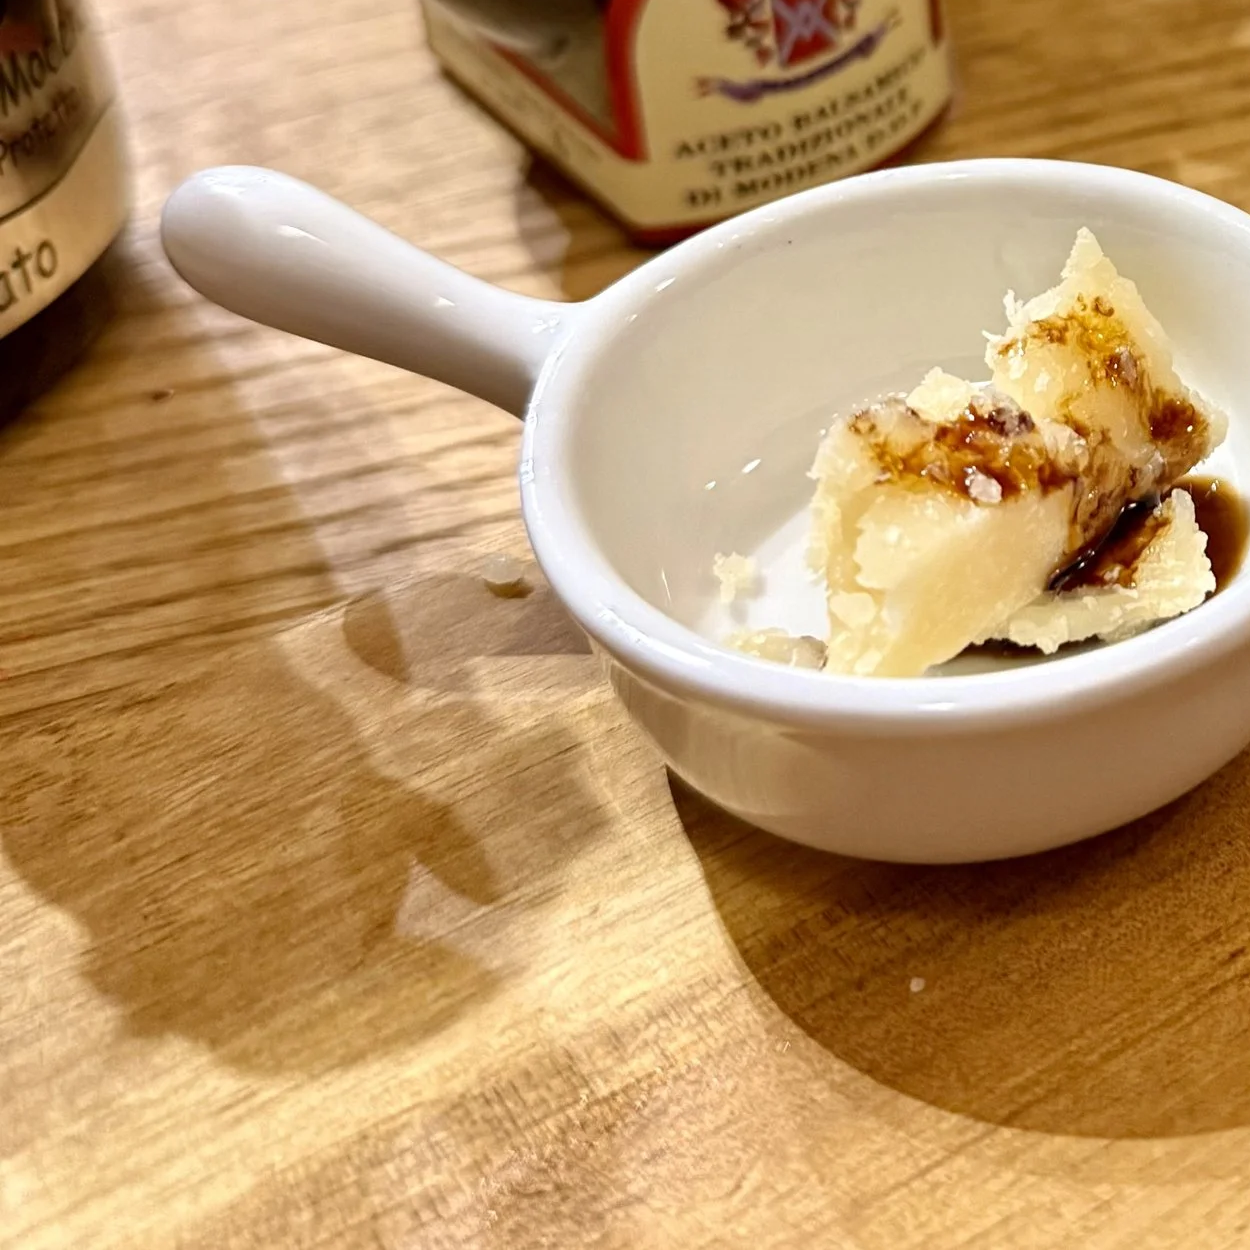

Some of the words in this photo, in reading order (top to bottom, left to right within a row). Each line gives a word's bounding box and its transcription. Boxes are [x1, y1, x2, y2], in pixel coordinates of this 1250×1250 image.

[676, 121, 782, 159] ACETO
[686, 186, 722, 208] DI
[732, 143, 860, 198] MODENA
